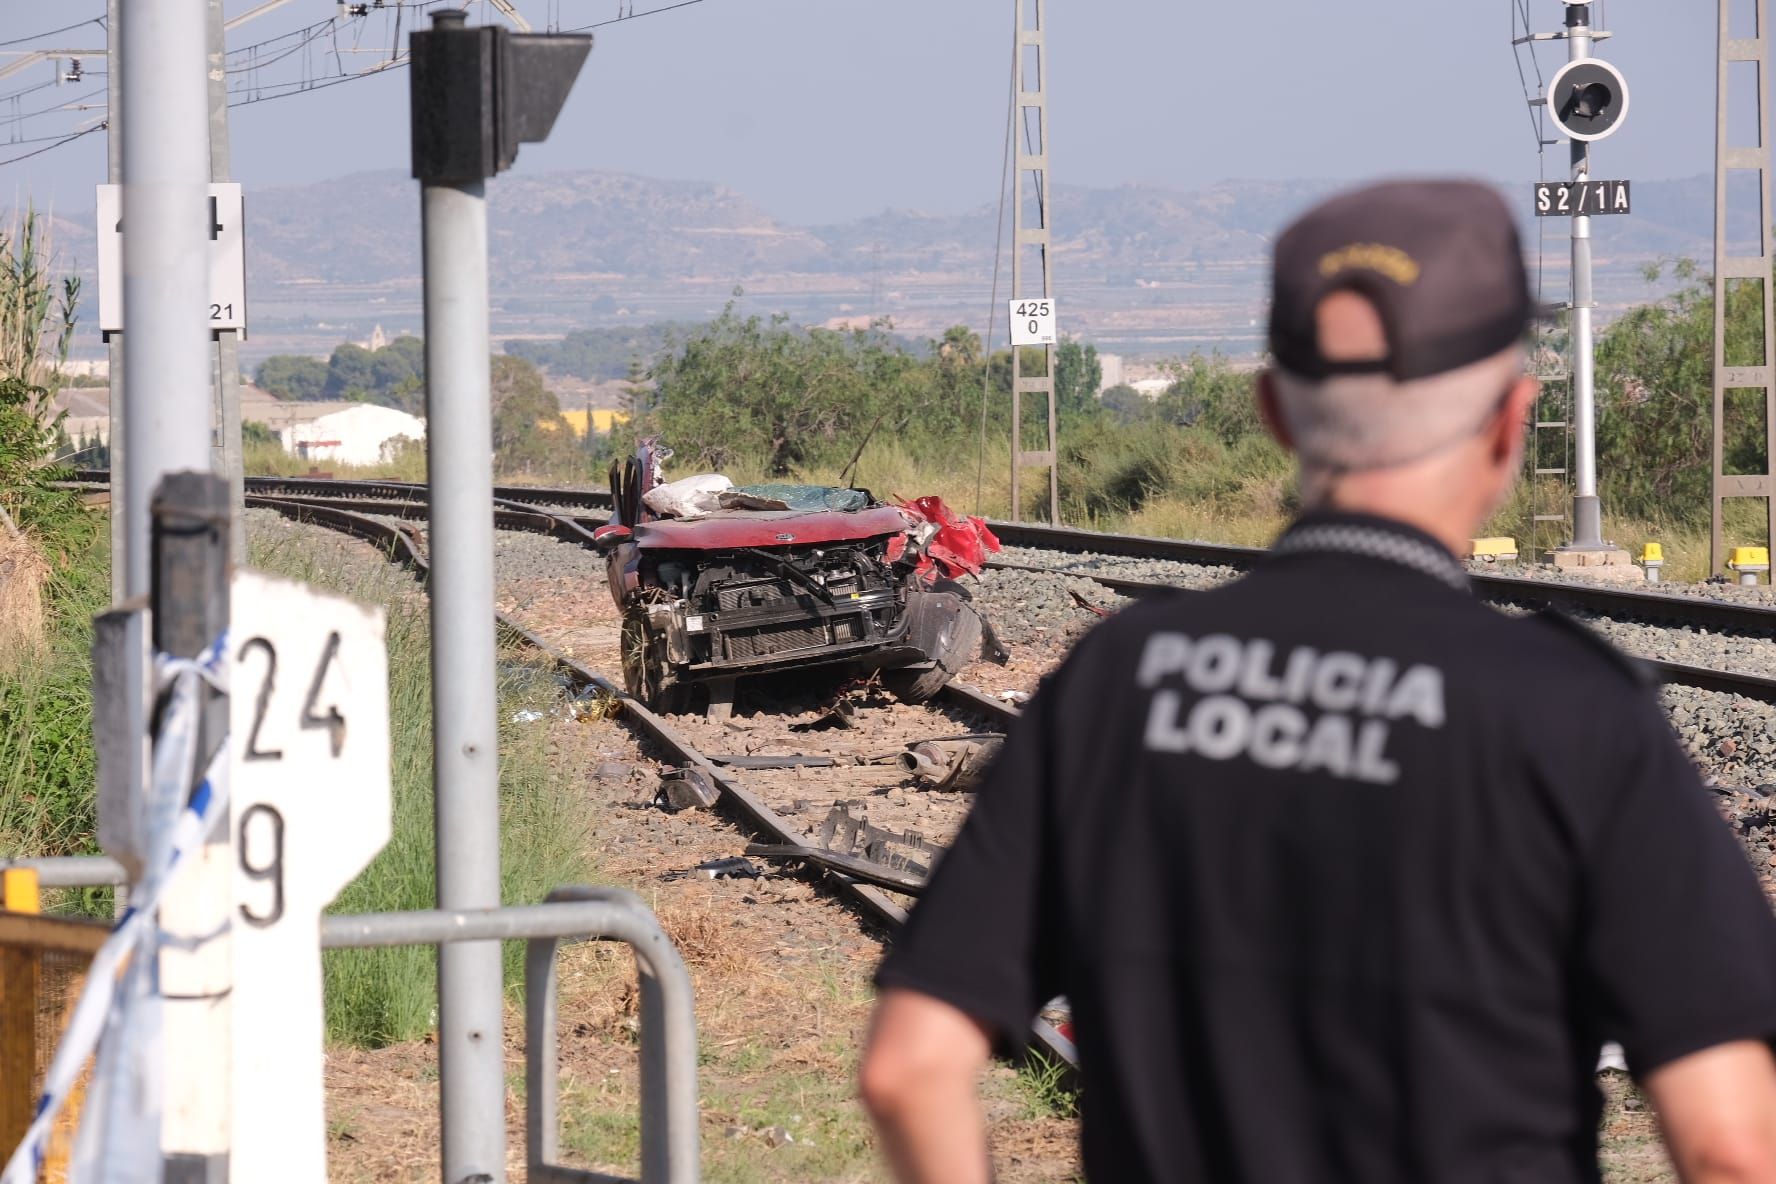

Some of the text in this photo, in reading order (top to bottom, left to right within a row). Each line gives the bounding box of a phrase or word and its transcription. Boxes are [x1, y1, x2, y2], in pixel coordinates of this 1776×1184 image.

[1538, 185, 1628, 212] S2/1A
[209, 303, 233, 320] 21
[1016, 302, 1050, 317] 425
[1028, 319, 1038, 335] 0
[237, 630, 347, 761] 24
[1137, 631, 1446, 729] POLICIA
[1144, 690, 1399, 785] LOCAL
[237, 802, 285, 928] 9
